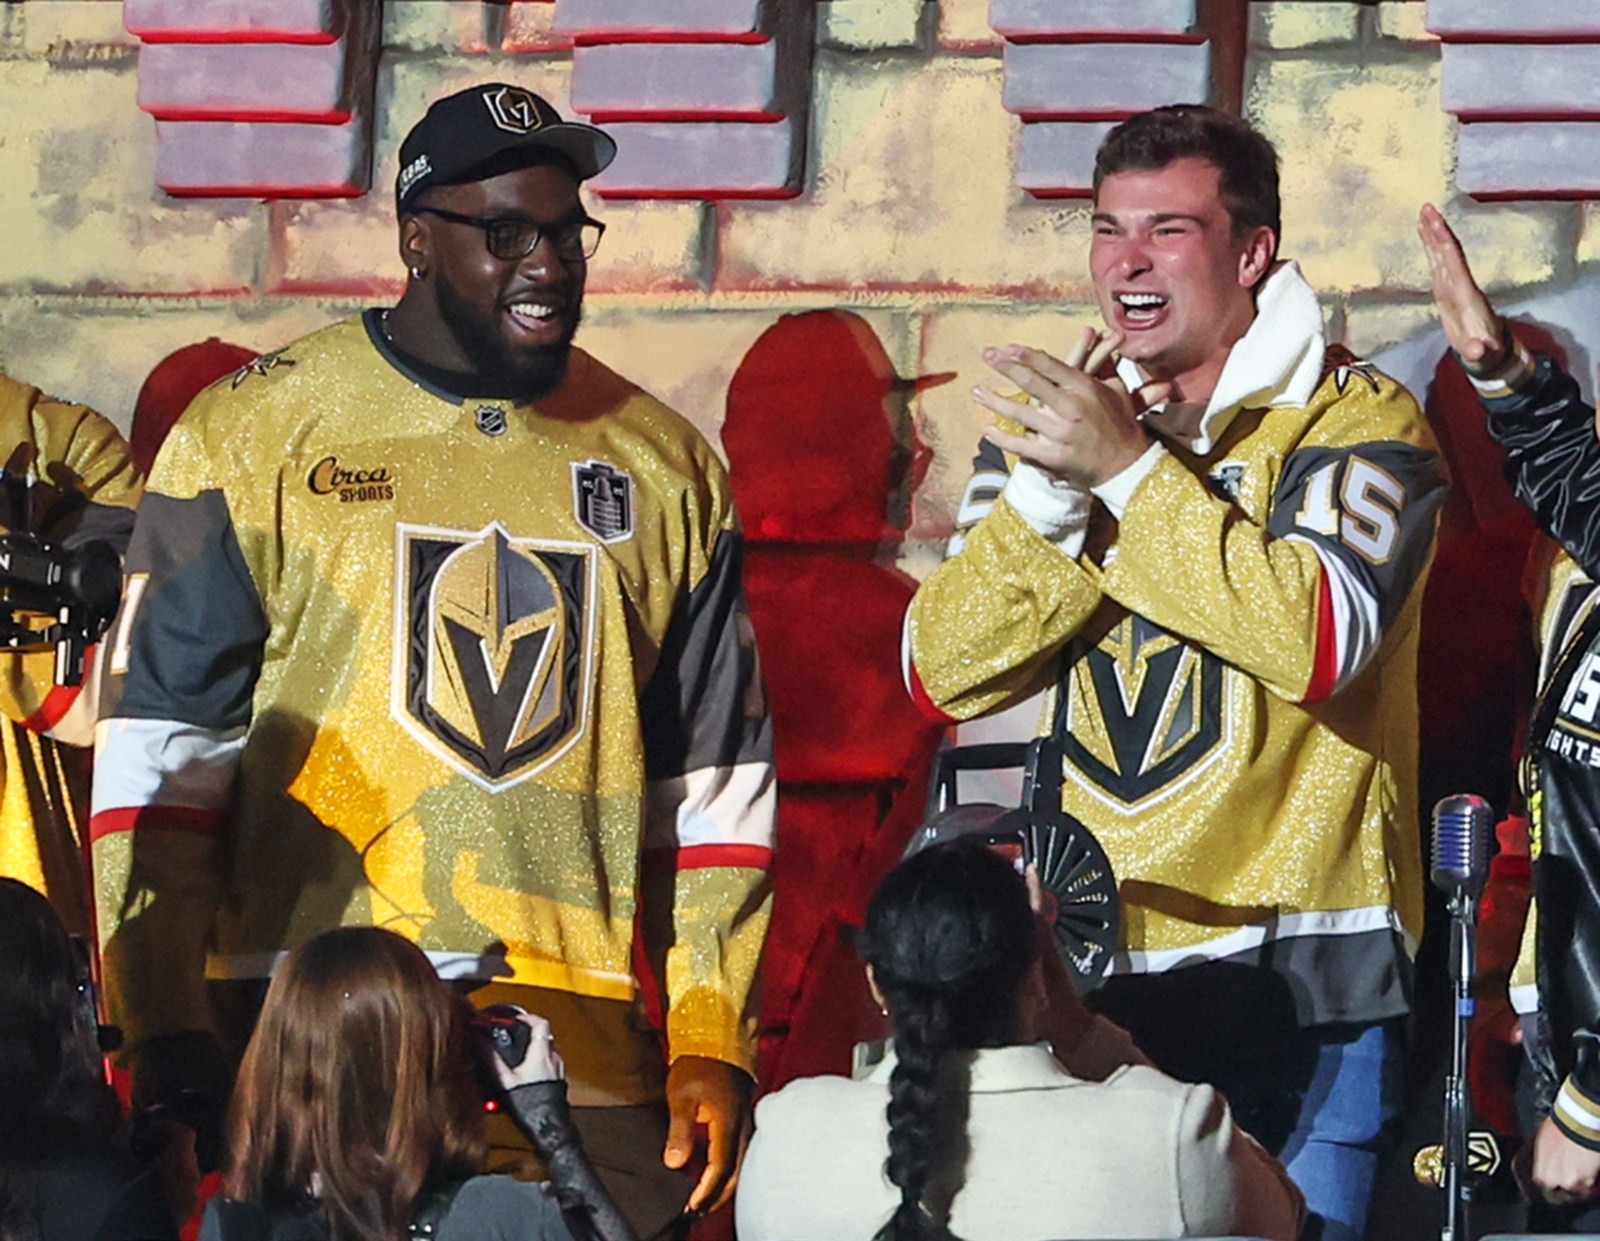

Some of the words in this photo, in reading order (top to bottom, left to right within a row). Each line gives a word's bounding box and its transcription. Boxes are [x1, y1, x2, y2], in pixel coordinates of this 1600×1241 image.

[307, 456, 393, 496] Circa
[340, 484, 394, 503] SPORTS
[1295, 453, 1406, 566] 15
